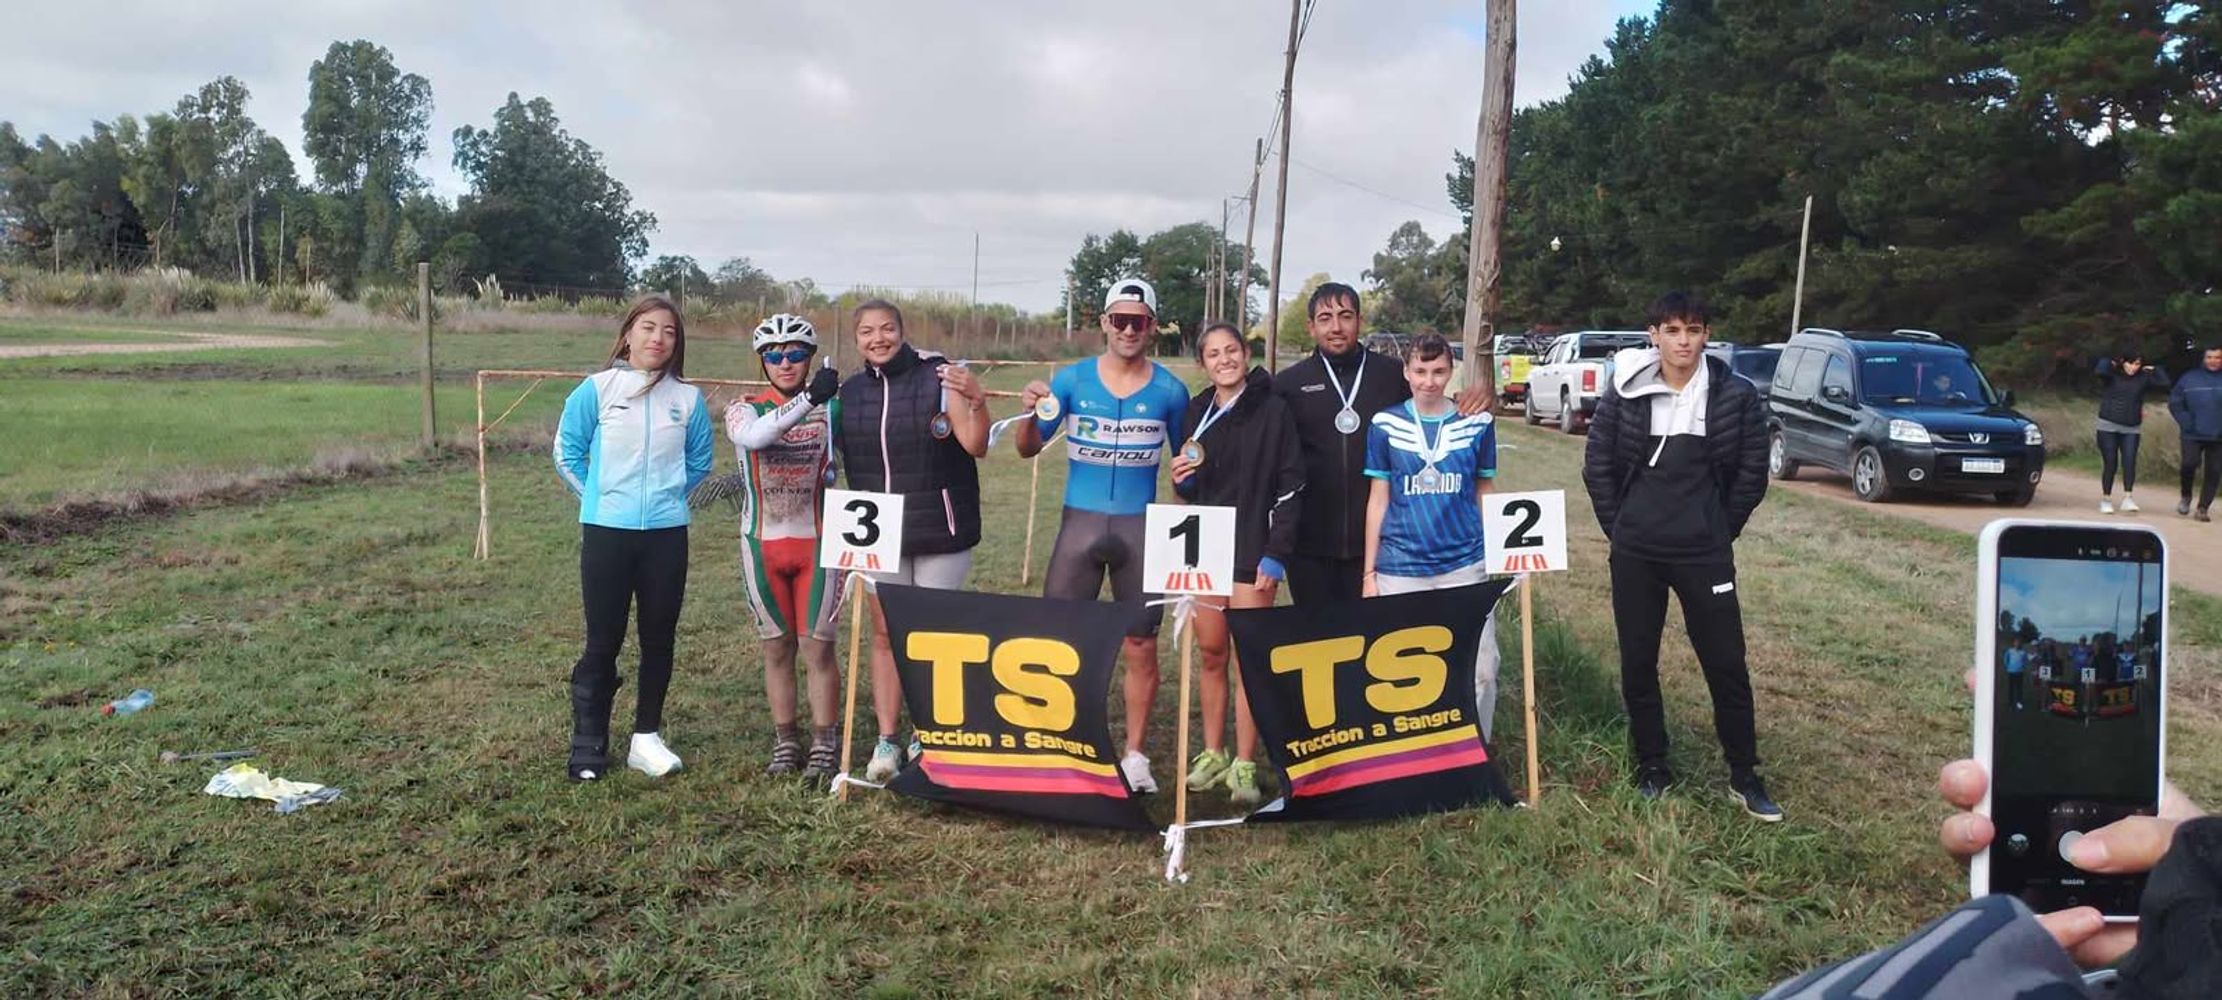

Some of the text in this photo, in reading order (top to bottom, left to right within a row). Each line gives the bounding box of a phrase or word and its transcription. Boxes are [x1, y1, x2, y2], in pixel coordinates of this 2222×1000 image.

[1103, 424, 1160, 433] RAWSON
[842, 499, 880, 547] 3
[1168, 514, 1200, 568] 1
[1502, 499, 1544, 549] 2
[839, 551, 881, 569] UA
[1165, 572, 1213, 590] UCA
[1504, 553, 1549, 571] UCA
[906, 631, 1081, 732] TS
[1270, 625, 1453, 730] TS
[1000, 733, 1016, 748] a
[1024, 731, 1097, 758] Sangre
[1286, 708, 1462, 758] Traccion a Sangre
